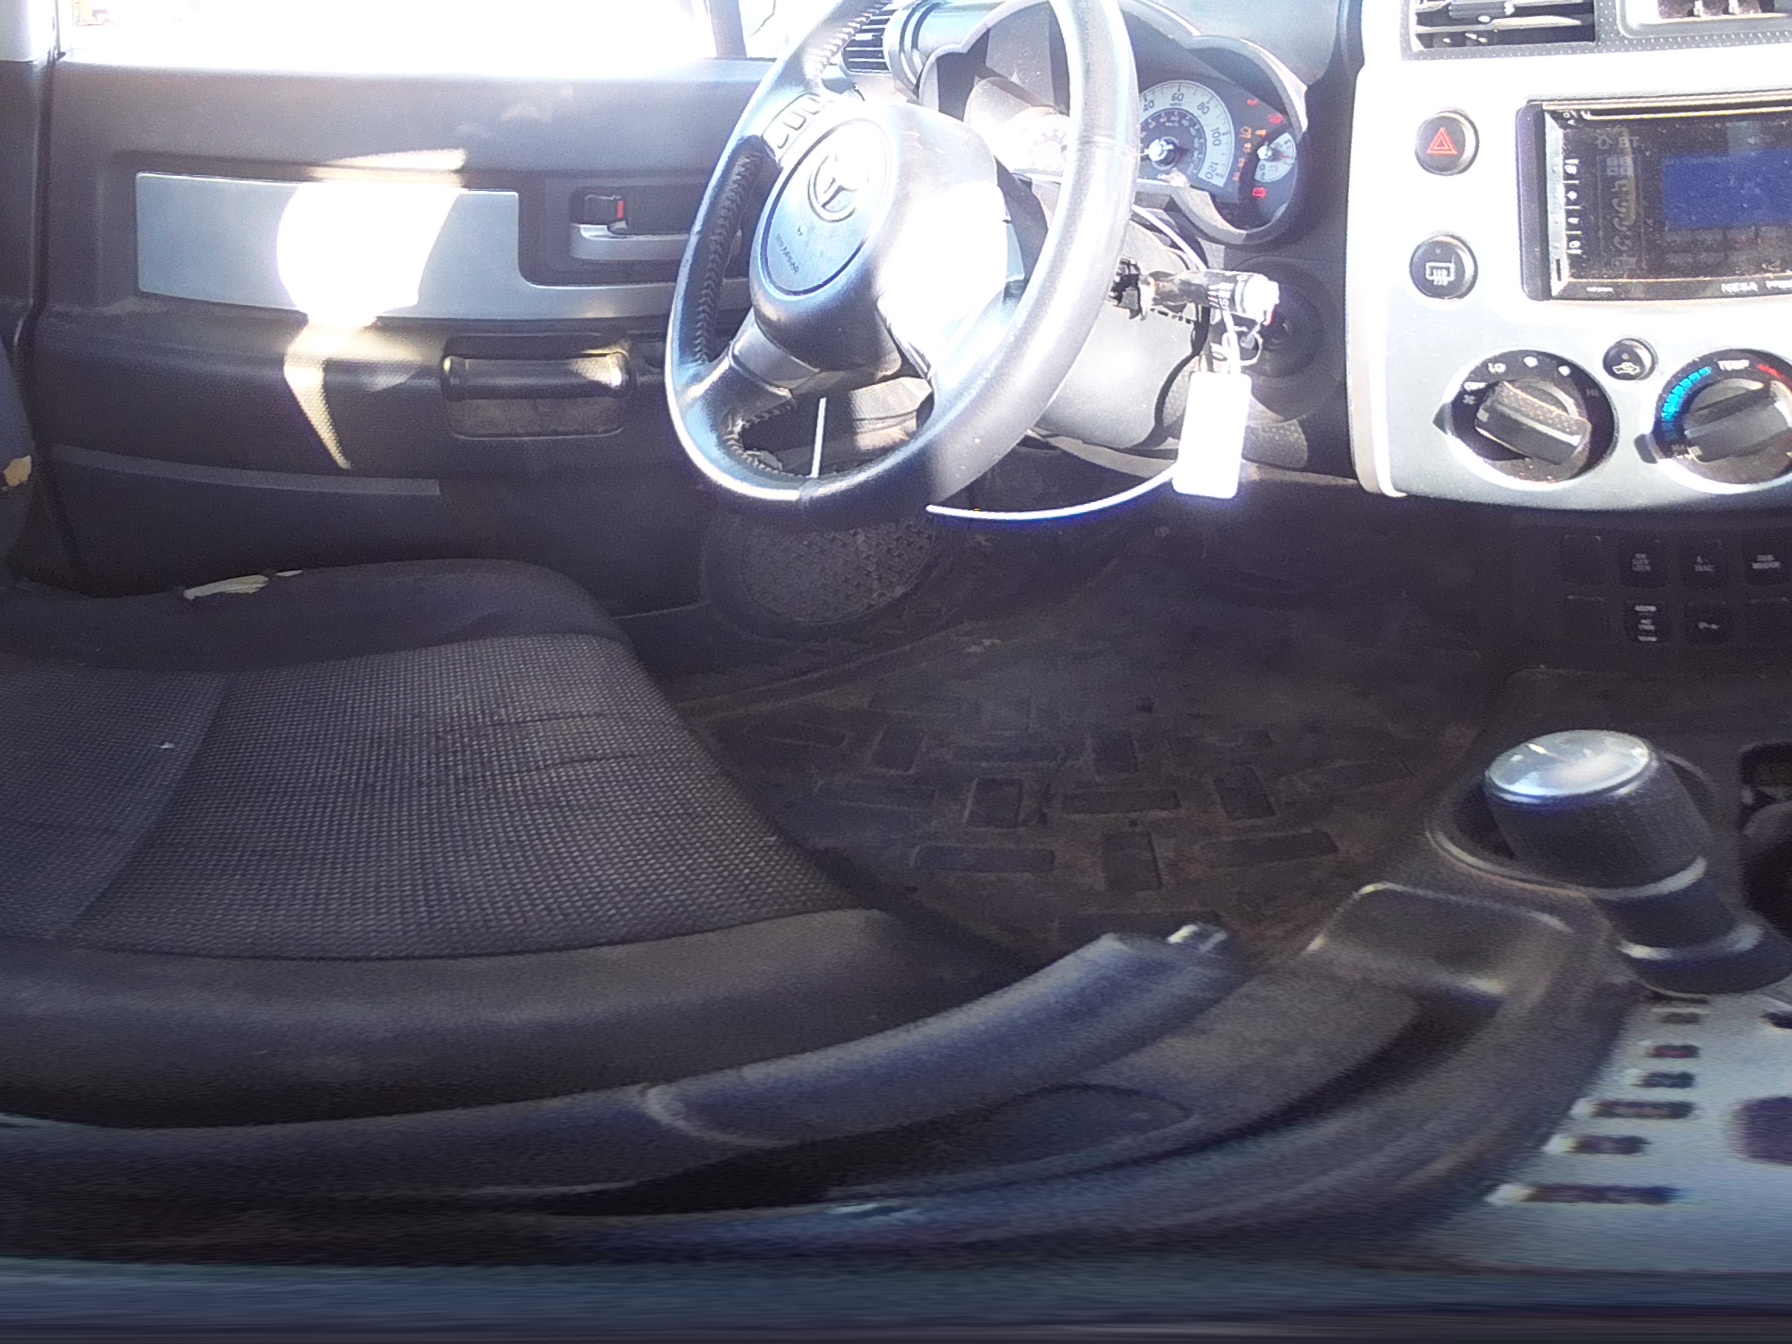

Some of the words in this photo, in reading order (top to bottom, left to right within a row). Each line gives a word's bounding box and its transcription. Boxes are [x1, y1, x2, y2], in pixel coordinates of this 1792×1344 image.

[1171, 92, 1185, 102] 60
[1143, 100, 1155, 112] 40
[1197, 102, 1210, 115] 80
[1211, 127, 1222, 146] 100
[1205, 161, 1219, 180] 120
[1720, 281, 1758, 295] NESA
[1488, 362, 1507, 374] LO
[1717, 359, 1750, 371] TEMP
[1586, 387, 1599, 398] HI
